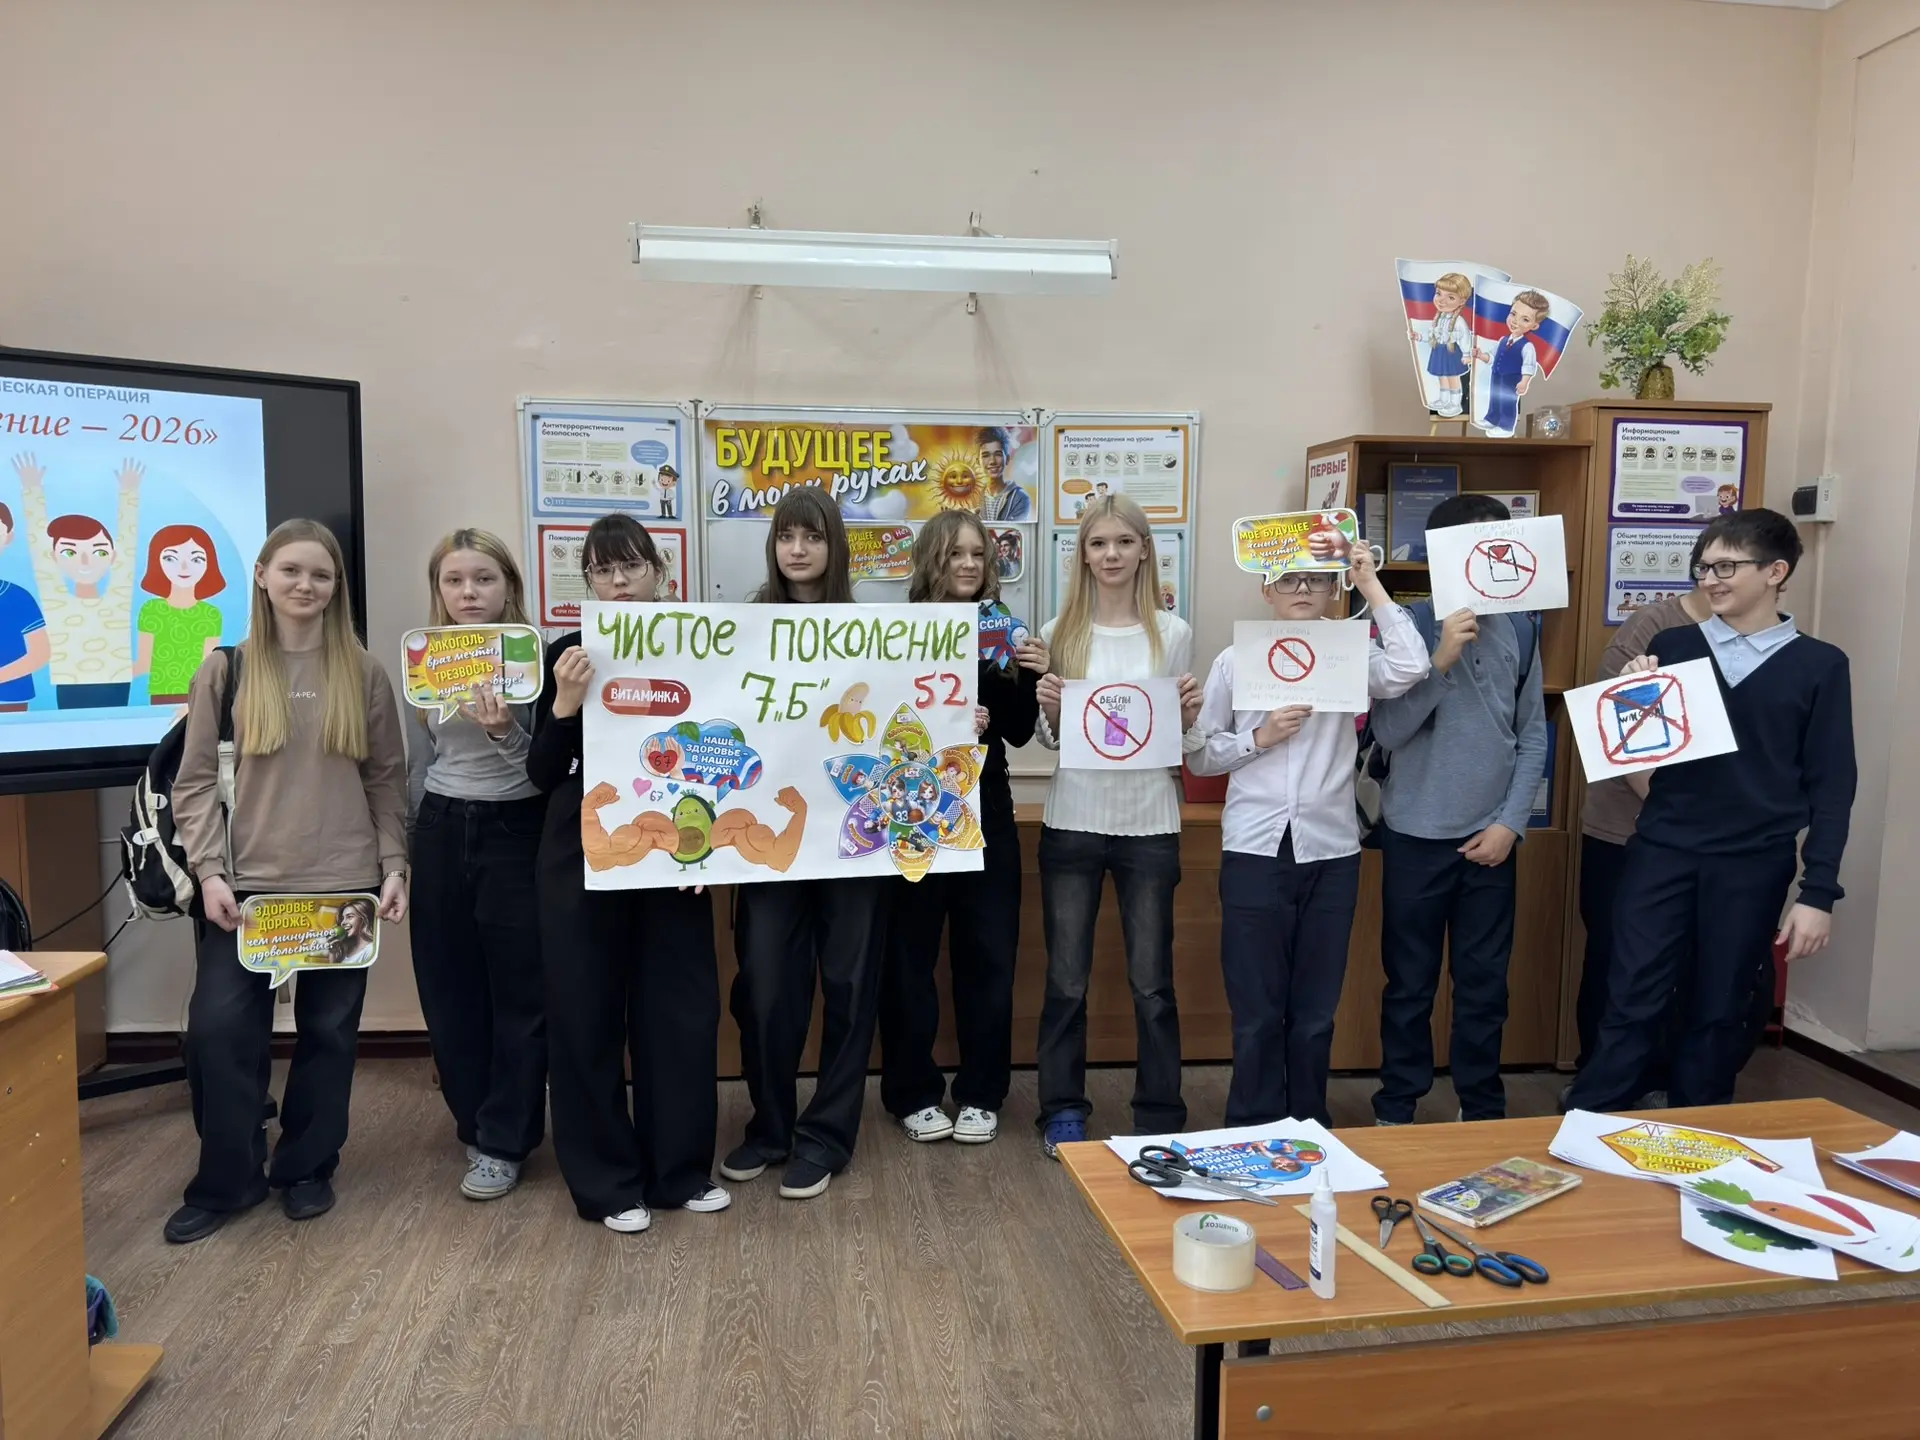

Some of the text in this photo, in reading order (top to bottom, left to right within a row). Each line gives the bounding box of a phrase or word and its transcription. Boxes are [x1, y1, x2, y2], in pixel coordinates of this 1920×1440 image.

[0, 380, 150, 404] ЕСКАЯ ОПЕРАЦИЯ
[119, 413, 218, 446] 2026»
[541, 421, 624, 433] Антитеррористическая
[541, 429, 591, 438] безопасность
[1622, 427, 1680, 435] Информационная
[1621, 434, 1666, 442] безопасность
[715, 427, 893, 476] БУДУЩЕЕ
[1310, 458, 1347, 479] ПЕРВЫЕ
[711, 478, 731, 516] в
[829, 457, 928, 503] руках
[849, 531, 874, 543] ДУЩЕЕ
[1263, 522, 1310, 539] БУДУЩЕЕ
[860, 541, 883, 551] РУКАХ
[1281, 537, 1297, 547] ум
[1259, 545, 1302, 557] чистый
[1260, 554, 1296, 567] выбор!
[978, 617, 1011, 630] ССИЯ
[598, 611, 971, 663] ЧИСТОЕ ПОКОЛЕНИЕ
[428, 633, 485, 655] АЛКОГОЛЬ
[426, 647, 500, 671] враг мечты,
[434, 661, 494, 683] ТРЕЗВОСТЬ
[437, 672, 524, 697] путь беде!
[914, 671, 969, 710] 52
[610, 686, 680, 704] ВИТАМИНКА
[703, 736, 735, 746] НАШЕ
[685, 744, 741, 757] ЗДОРОВЬЕ
[654, 755, 672, 768] 67
[701, 756, 740, 767] НАШИХ
[695, 765, 732, 775] РУКАХ!
[650, 790, 664, 802] 67
[895, 810, 908, 822] 33
[254, 900, 314, 917] ЗДОРОВЬЕ
[258, 915, 311, 933] ДОРОЖЕ,
[246, 936, 268, 947] чем
[1184, 1148, 1232, 1161] НАЦИЯ
[1205, 1159, 1244, 1171] ДЕТИ
[1643, 1153, 1712, 1171] ОРОВЬЕ
